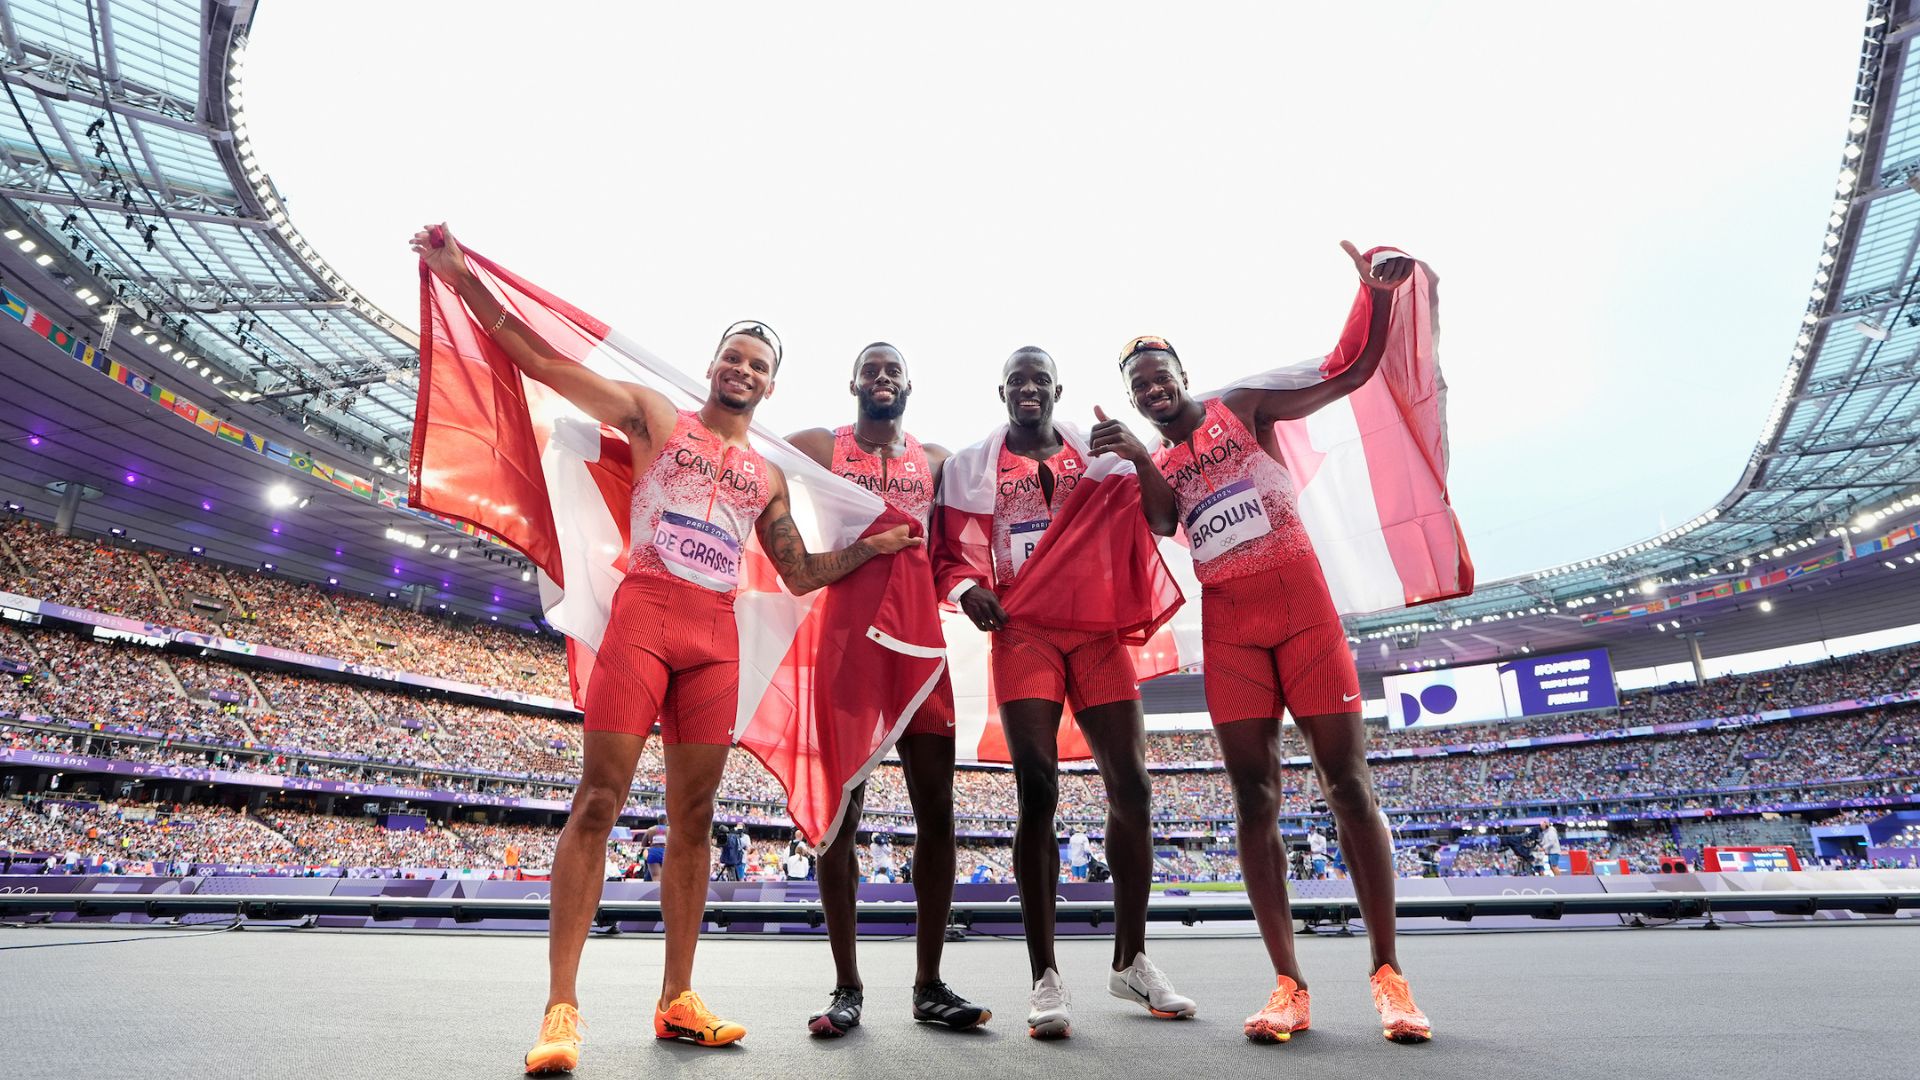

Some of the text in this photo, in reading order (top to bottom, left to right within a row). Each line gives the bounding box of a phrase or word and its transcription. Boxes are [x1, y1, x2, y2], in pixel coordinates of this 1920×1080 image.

[675, 448, 758, 498] CANADA
[1212, 489, 1231, 502] 2024
[686, 519, 709, 532] PARIS
[1192, 498, 1262, 549] BROWN
[655, 529, 736, 577] DE GRASSE
[61, 608, 123, 628] PARIS 2024
[31, 753, 89, 767] PARIS 2024
[395, 789, 414, 797] PARIS
